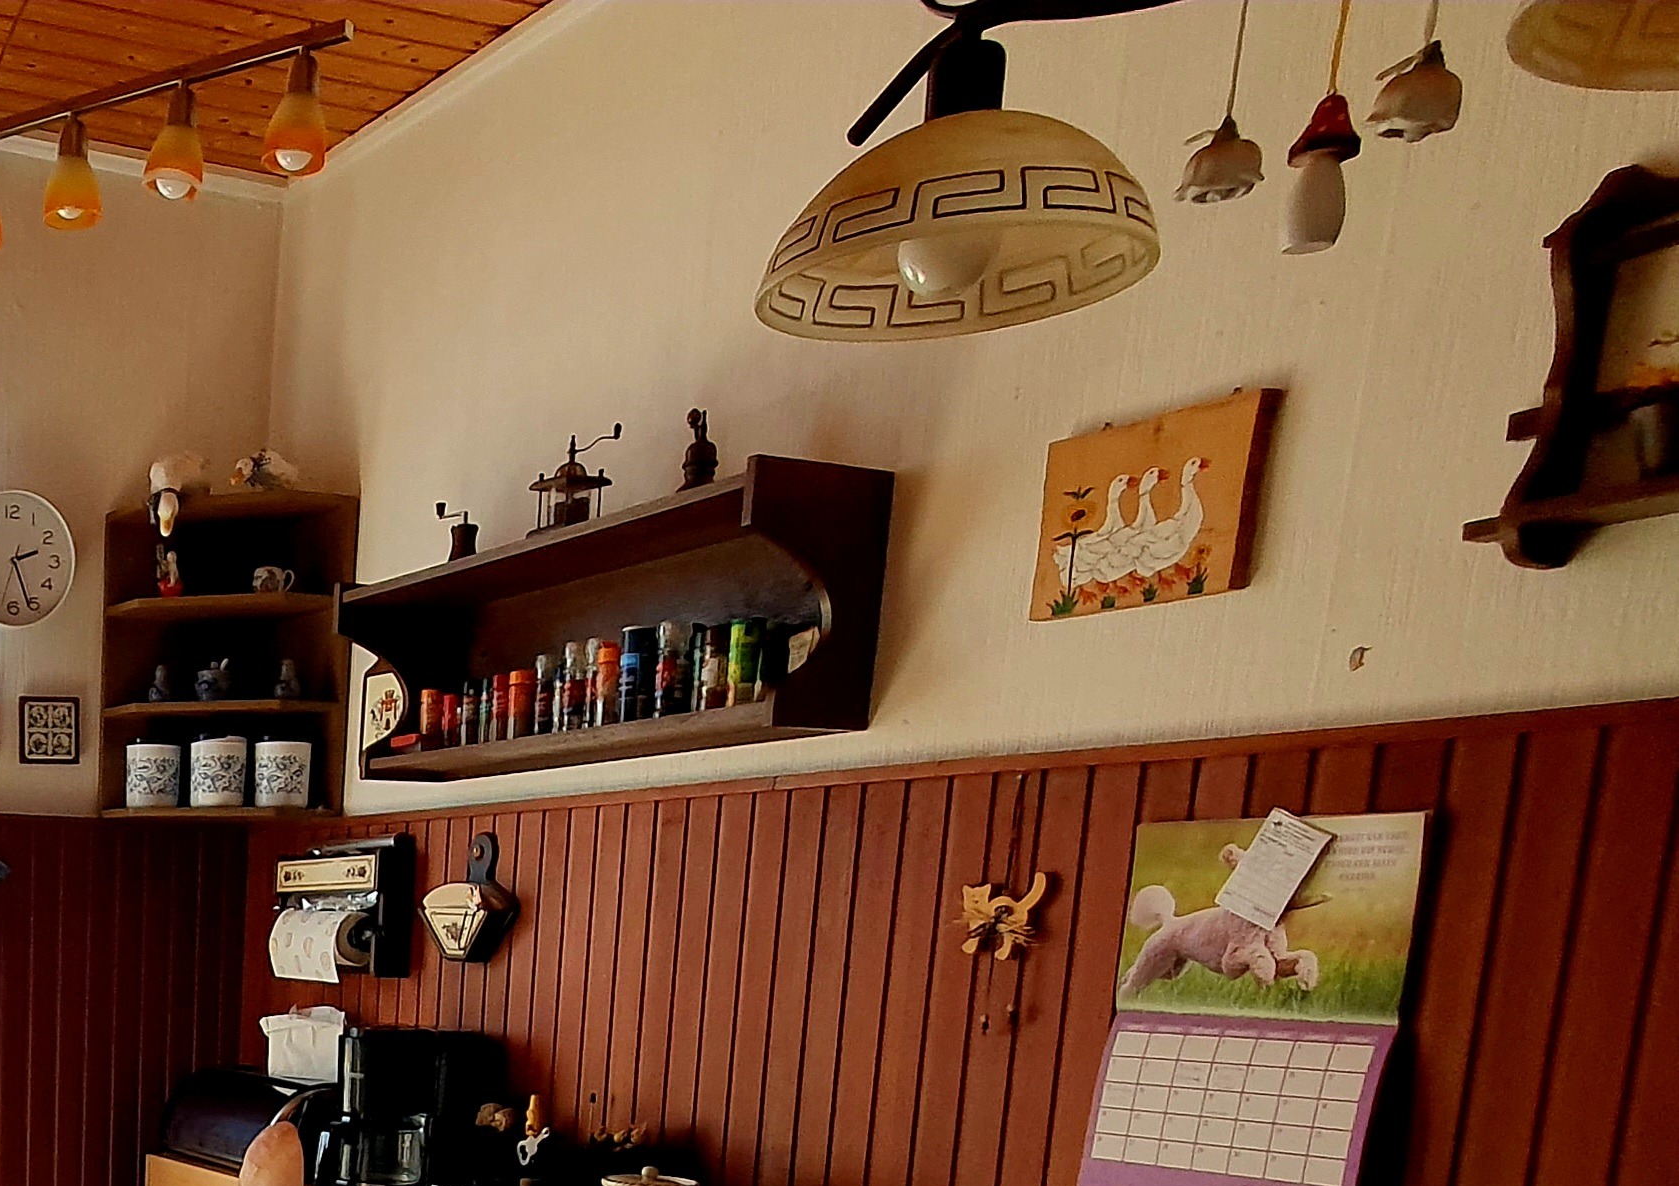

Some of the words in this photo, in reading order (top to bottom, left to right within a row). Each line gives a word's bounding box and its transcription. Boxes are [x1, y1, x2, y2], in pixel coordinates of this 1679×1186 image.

[5, 504, 20, 519] 12
[42, 530, 53, 545] 2
[48, 554, 60, 569] 3
[41, 578, 53, 590] 4
[6, 601, 20, 615] 6
[27, 597, 40, 611] 5
